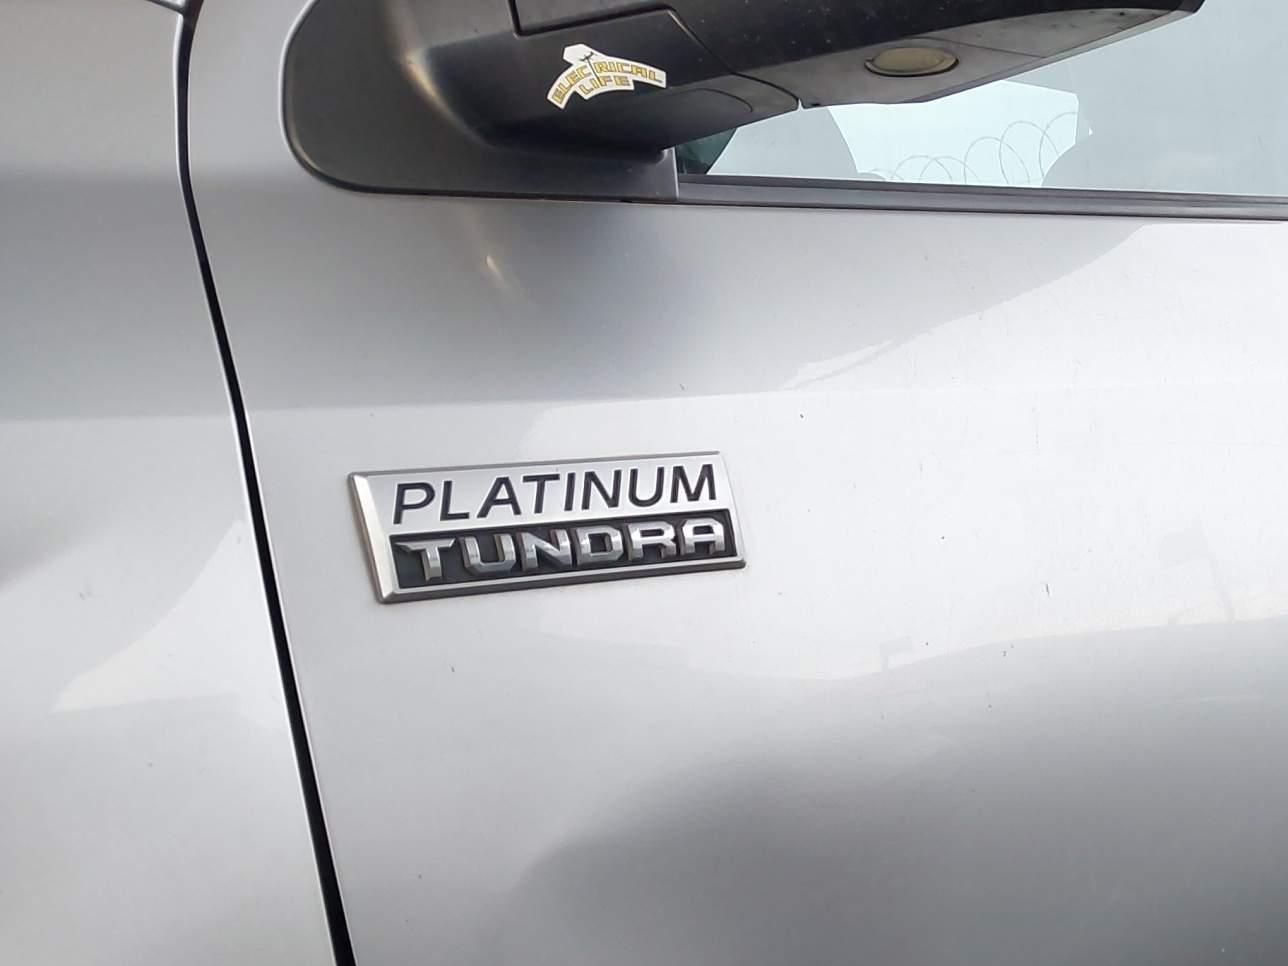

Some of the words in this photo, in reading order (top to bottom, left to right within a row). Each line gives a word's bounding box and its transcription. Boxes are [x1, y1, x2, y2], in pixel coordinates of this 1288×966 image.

[578, 75, 630, 96] LIFE
[393, 463, 717, 525] PLATINUM
[395, 518, 725, 582] TUNDRA
